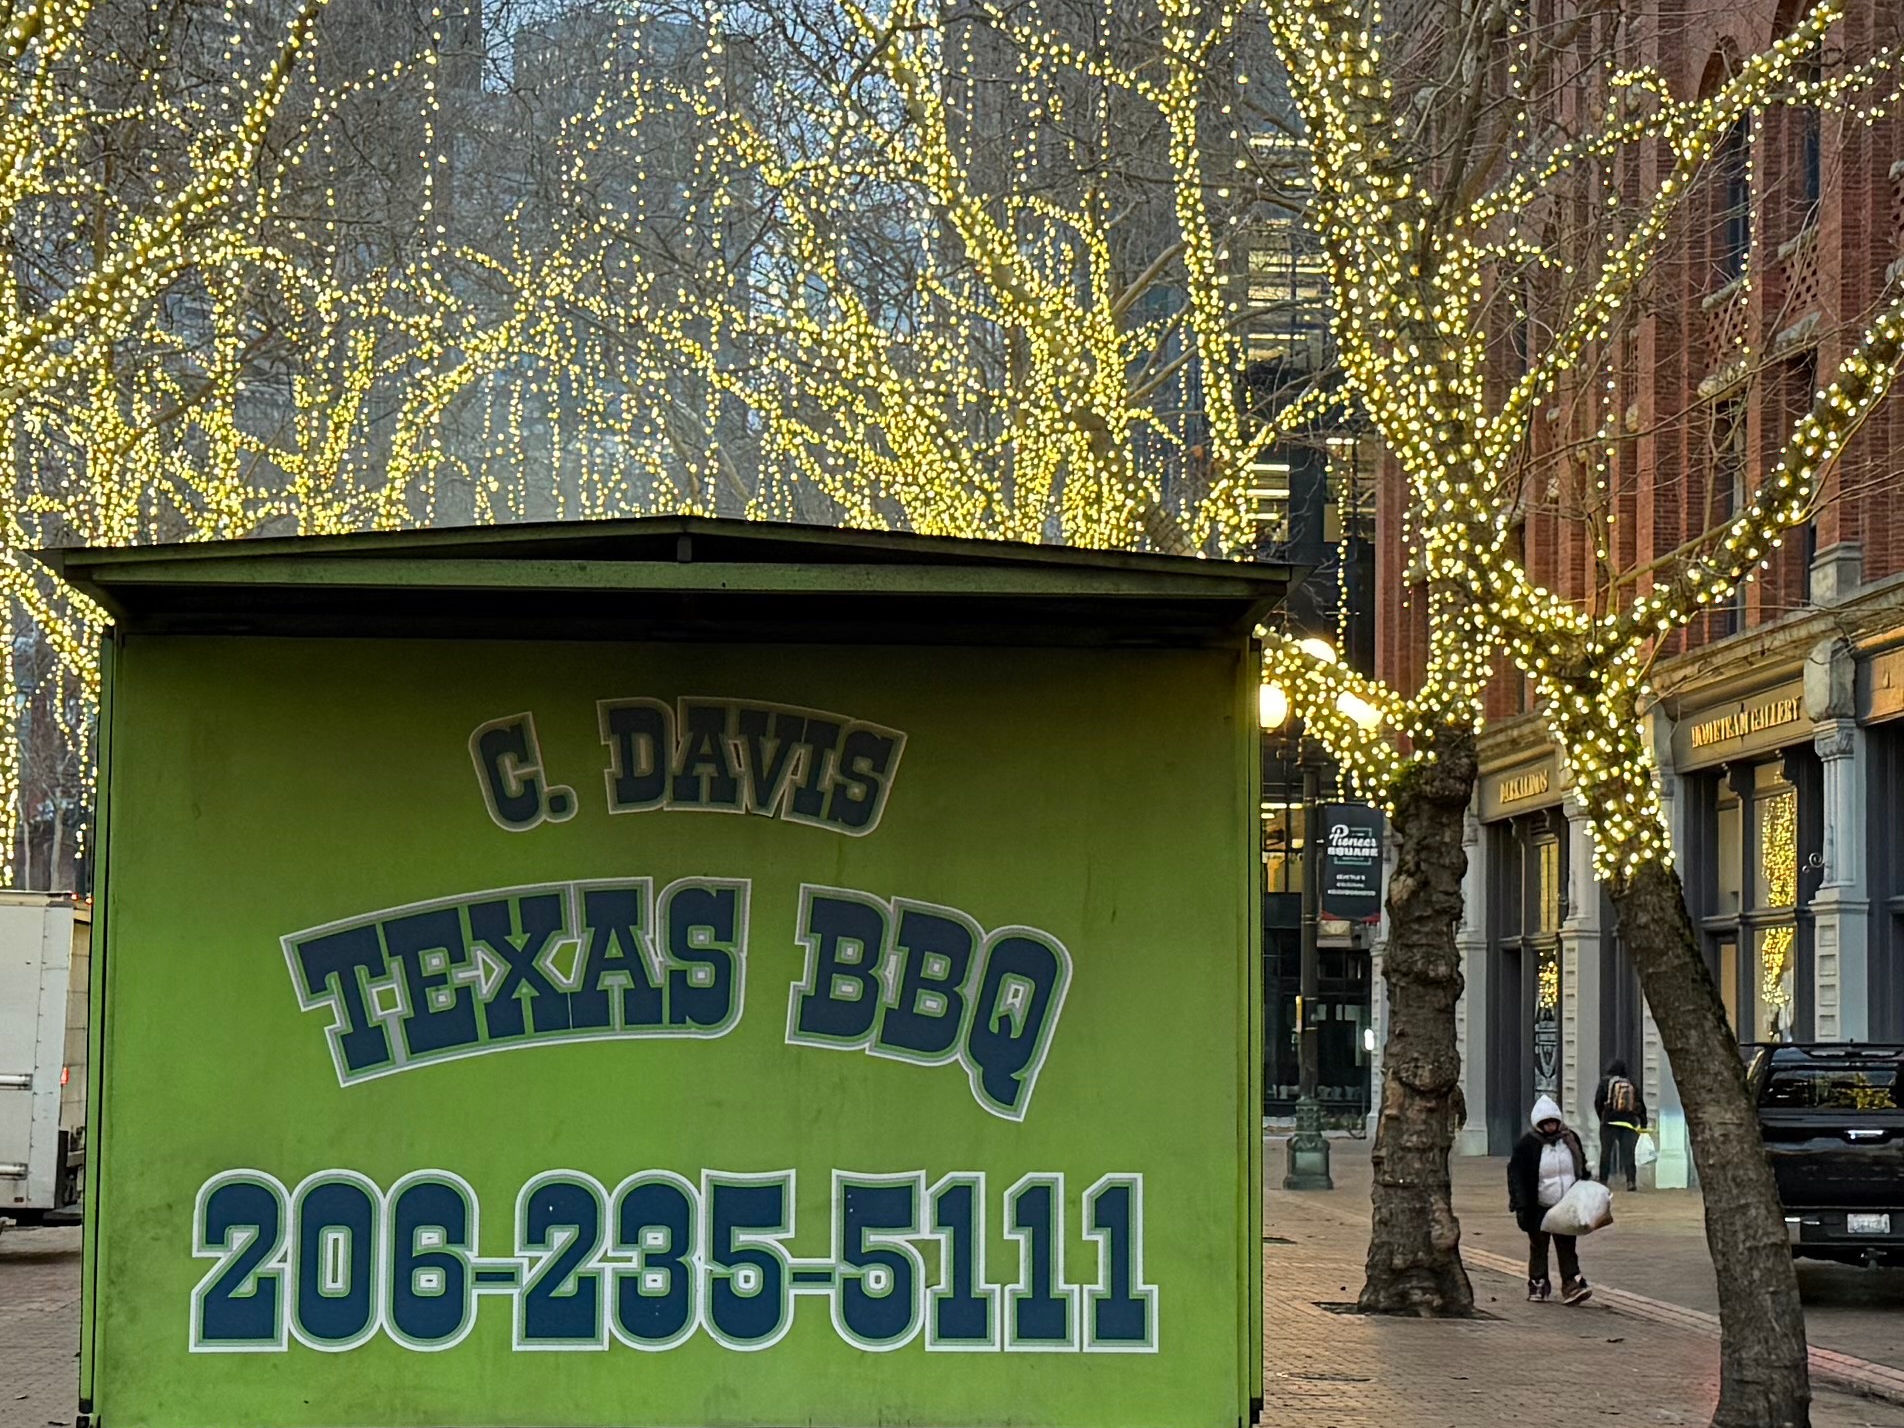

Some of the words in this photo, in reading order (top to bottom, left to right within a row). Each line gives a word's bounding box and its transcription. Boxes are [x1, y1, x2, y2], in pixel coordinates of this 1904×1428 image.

[468, 710, 578, 832] C.
[596, 696, 908, 838] DAVIS
[280, 877, 751, 1087] TEXAS
[786, 883, 1073, 1122] BBQ
[190, 1168, 1159, 1352] 206-235-5111
